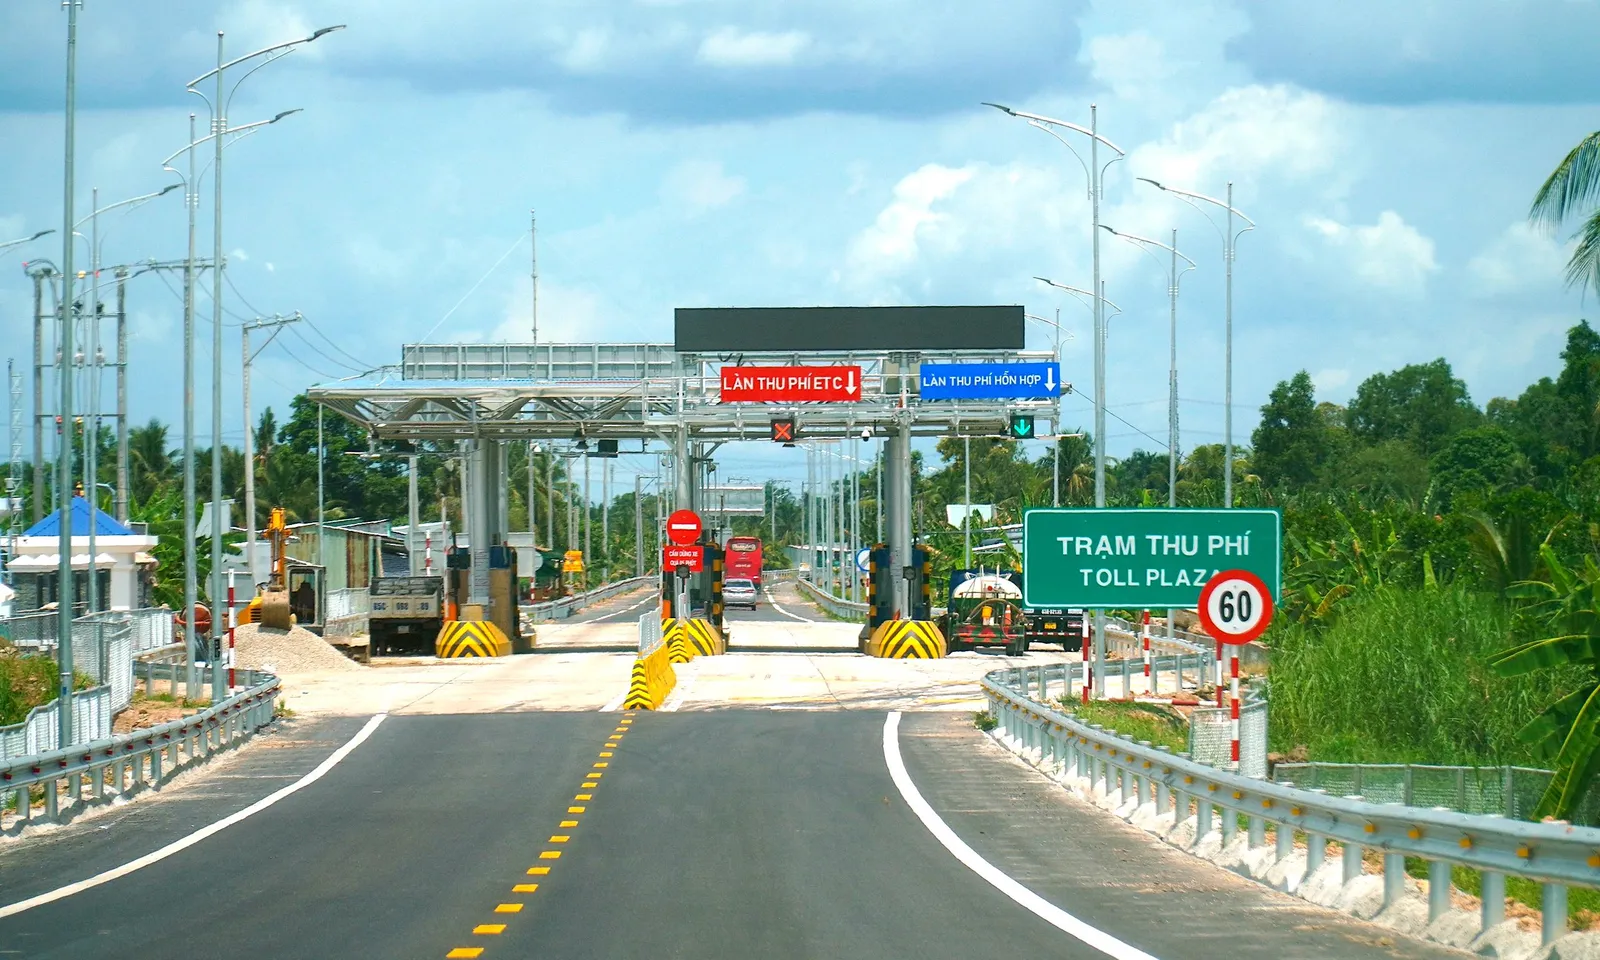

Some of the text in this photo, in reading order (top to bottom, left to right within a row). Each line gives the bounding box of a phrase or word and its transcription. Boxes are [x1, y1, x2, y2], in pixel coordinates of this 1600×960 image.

[723, 373, 843, 390] LÀN THU PHÍ ETC
[923, 371, 1042, 387] LÀN THU PHÍ HỖN HỢP
[1057, 530, 1252, 560] TRẠM THU PHÍ
[1079, 569, 1140, 587] TOLL
[1219, 590, 1252, 623] 60
